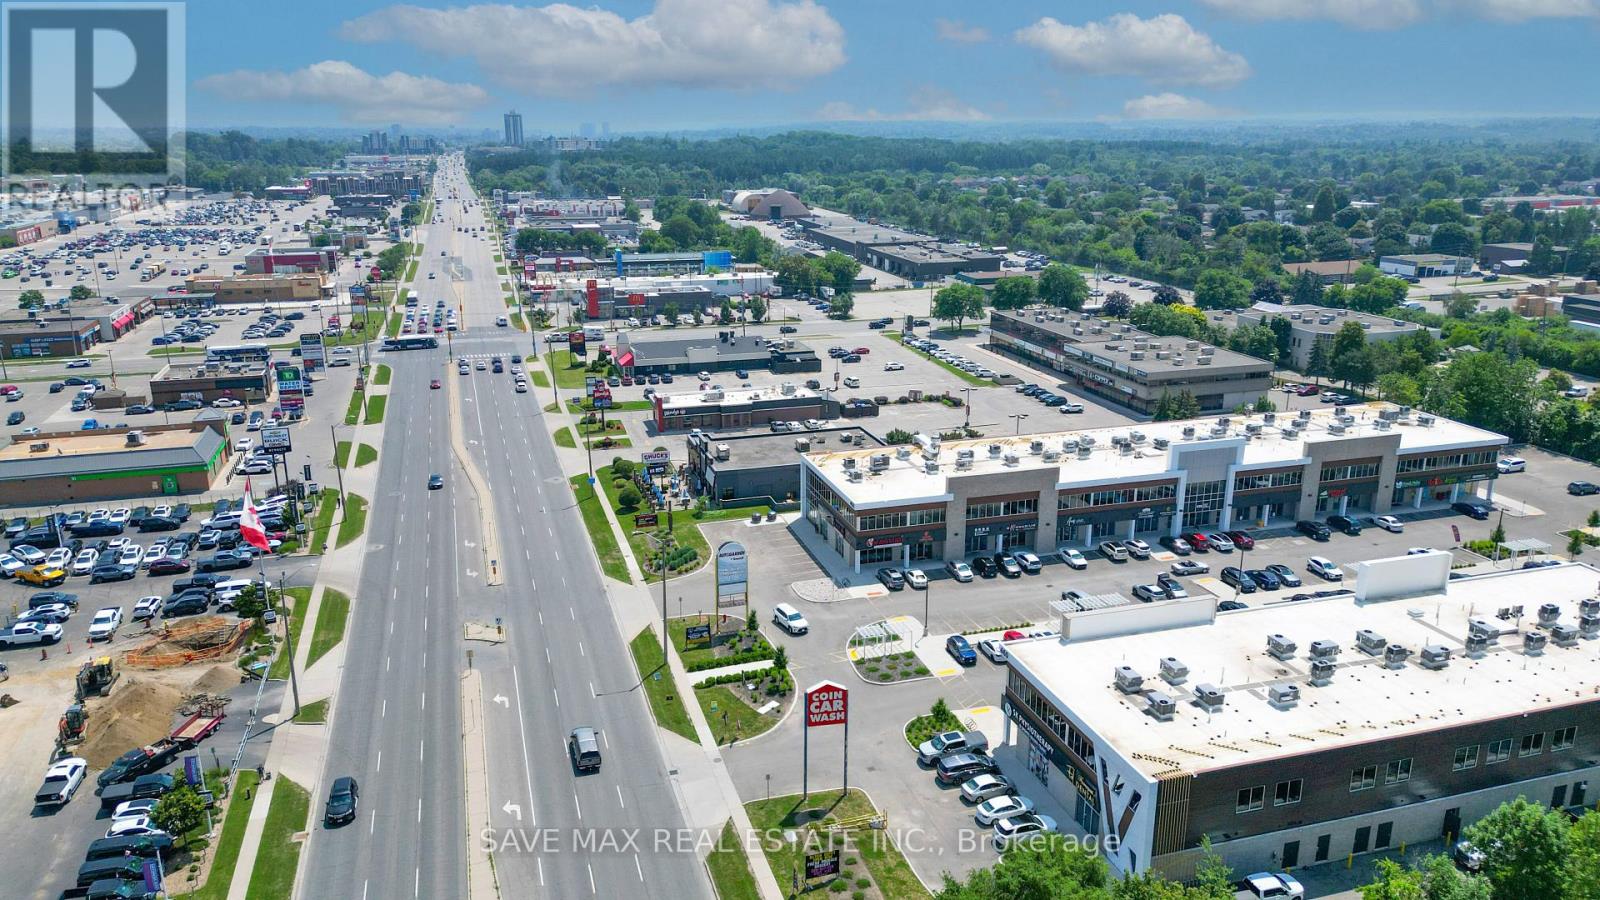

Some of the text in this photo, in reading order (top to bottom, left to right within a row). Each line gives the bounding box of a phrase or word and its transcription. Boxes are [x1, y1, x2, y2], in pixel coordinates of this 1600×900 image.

[812, 690, 843, 702] COIN
[810, 700, 844, 713] CAR
[810, 711, 845, 723] WASH
